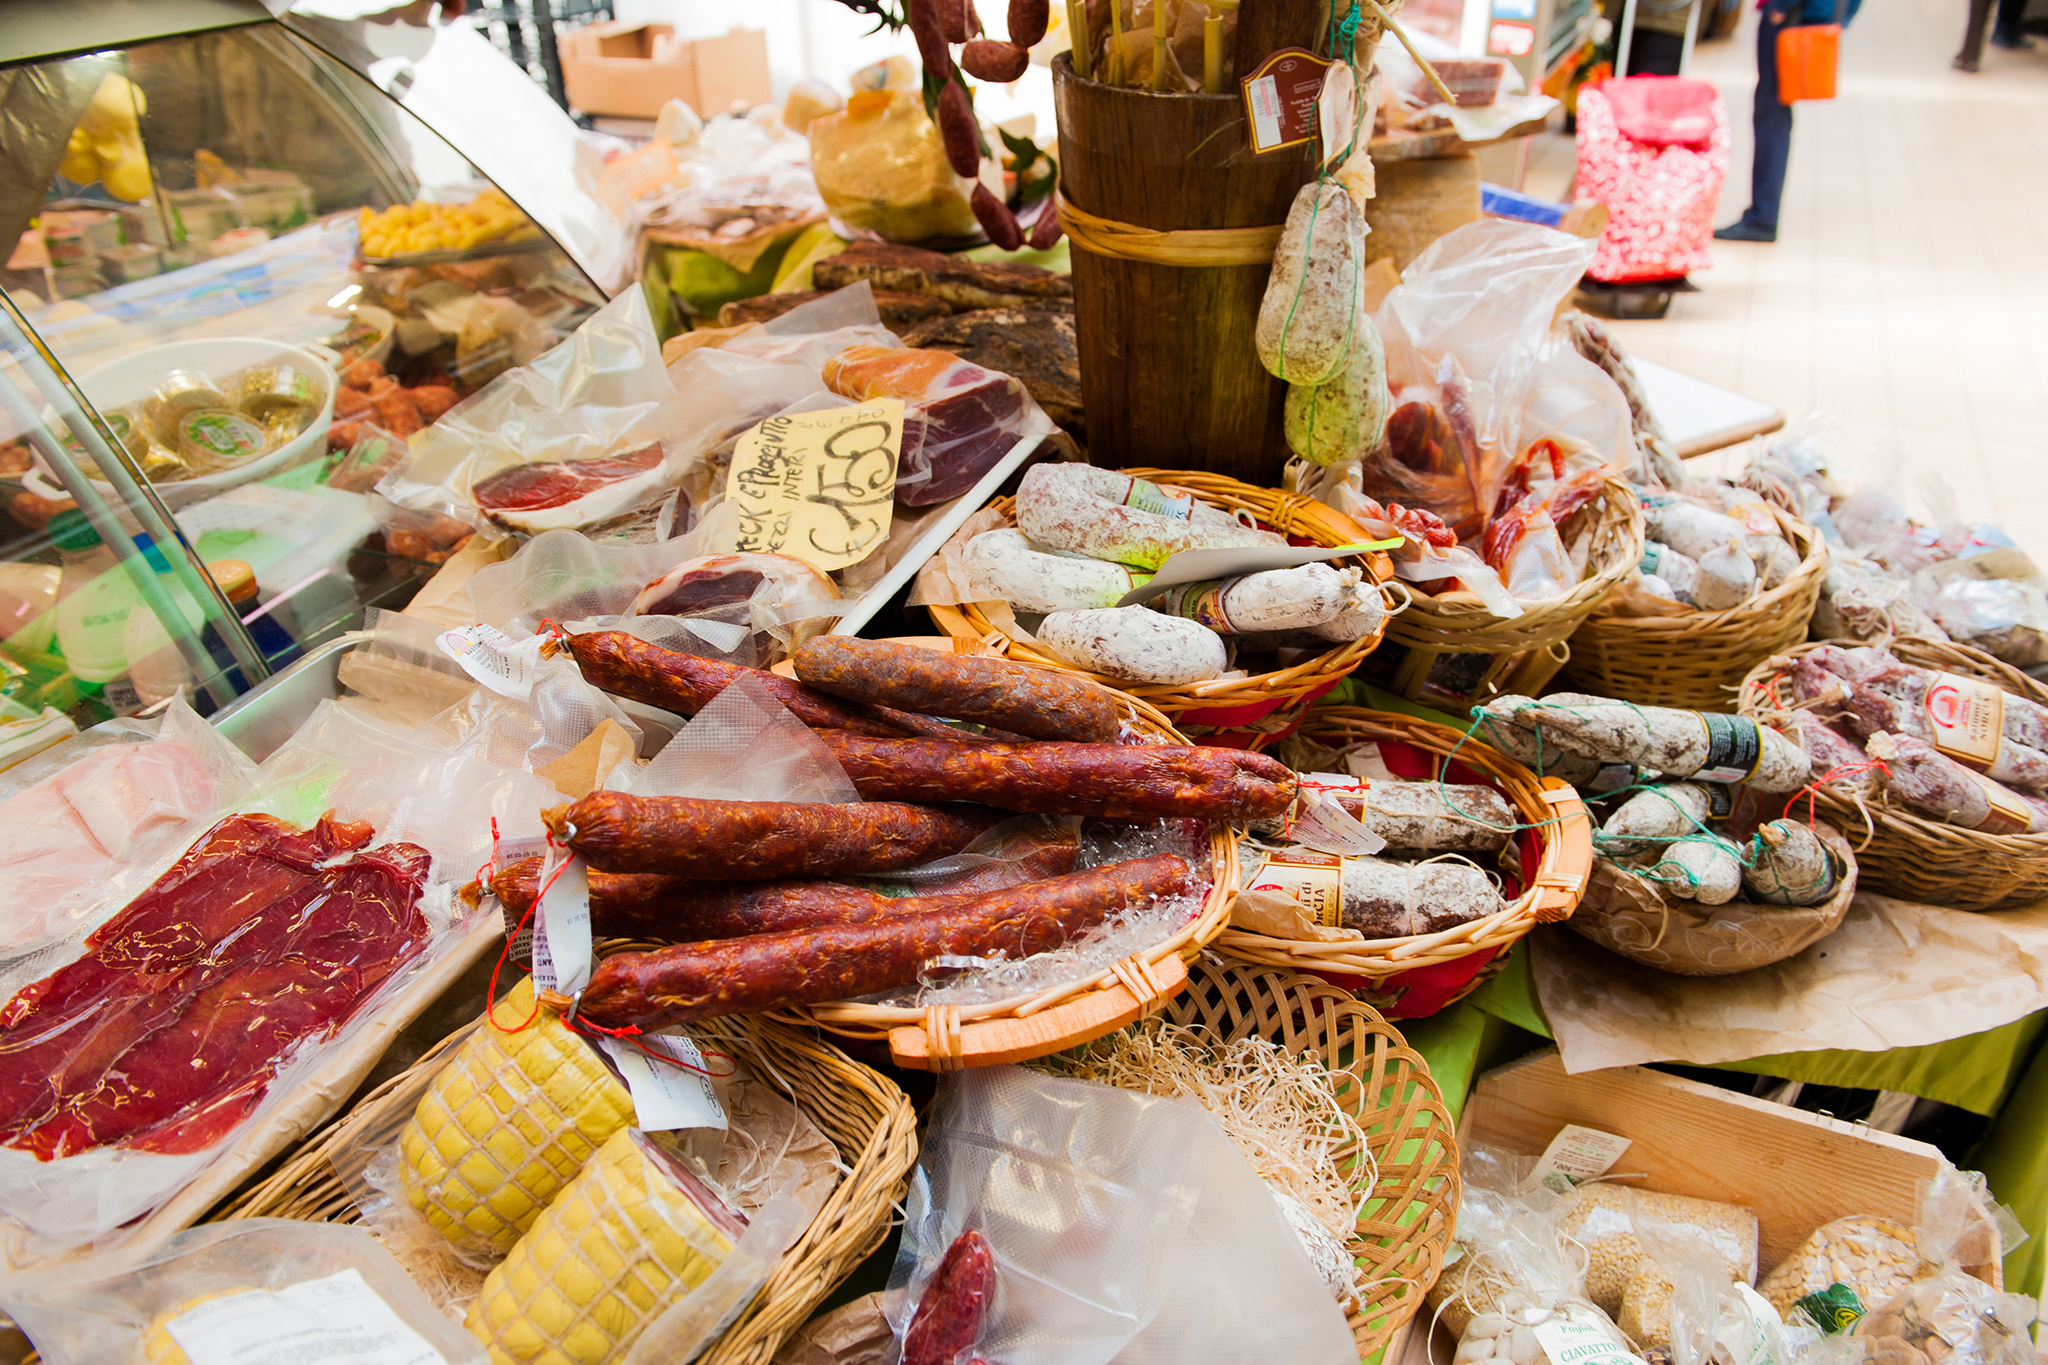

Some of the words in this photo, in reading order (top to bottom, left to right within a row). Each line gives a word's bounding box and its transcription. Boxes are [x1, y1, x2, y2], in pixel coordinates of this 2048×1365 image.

[1969, 703, 1981, 741] Salumi
[1979, 697, 1991, 740] NORCIA
[1313, 888, 1325, 927] ORCIA
[1328, 883, 1336, 917] NURSINO
